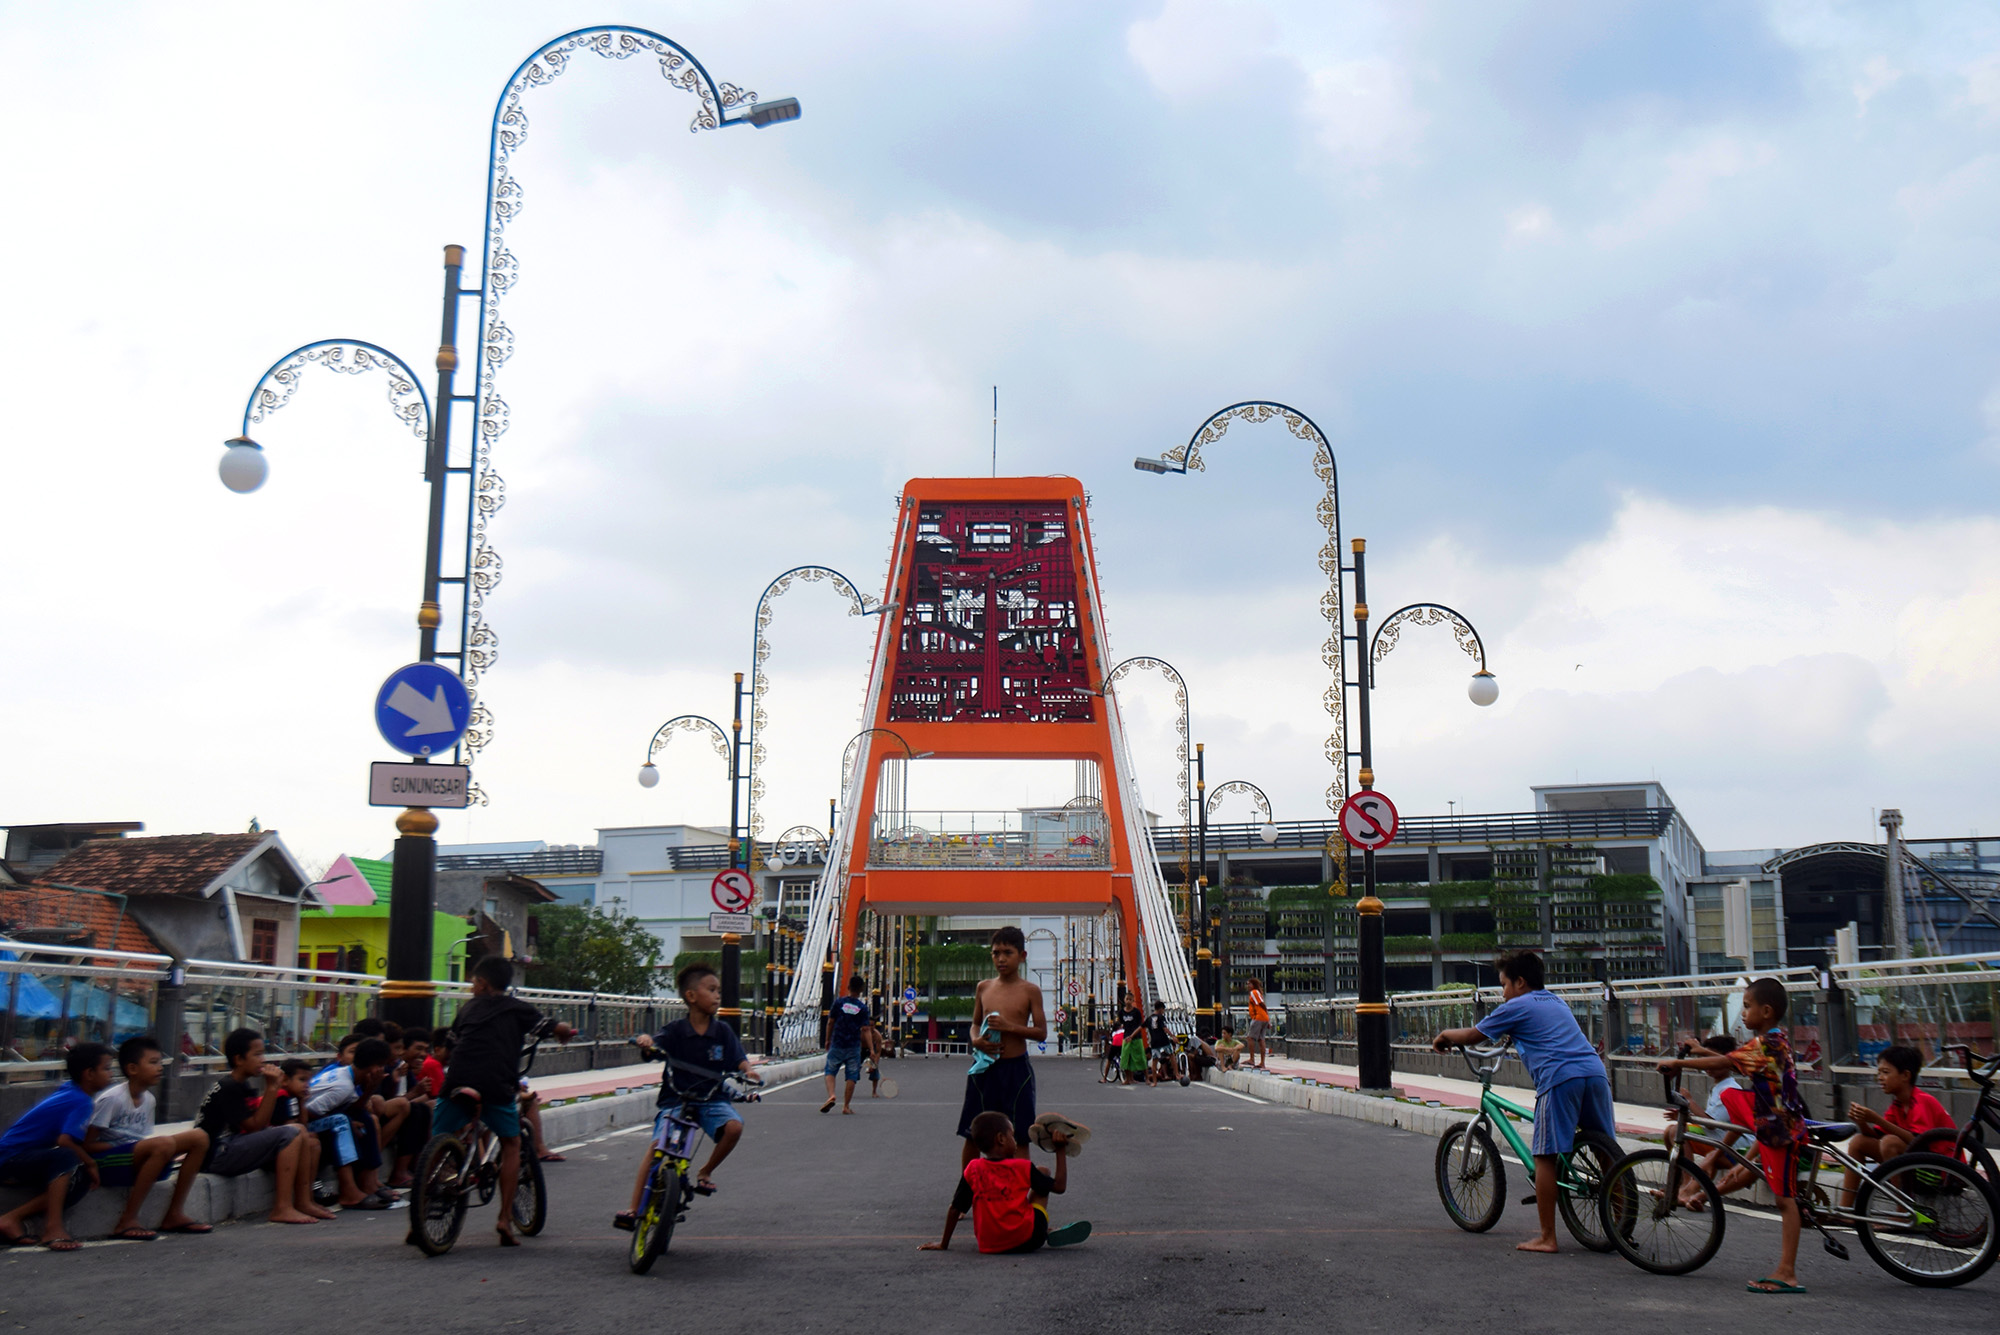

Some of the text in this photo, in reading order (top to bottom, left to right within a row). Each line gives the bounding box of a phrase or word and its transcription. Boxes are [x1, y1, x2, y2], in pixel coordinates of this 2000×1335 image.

[391, 776, 465, 796] GUNUNGSARI
[1359, 801, 1382, 840] S
[725, 876, 742, 904] S
